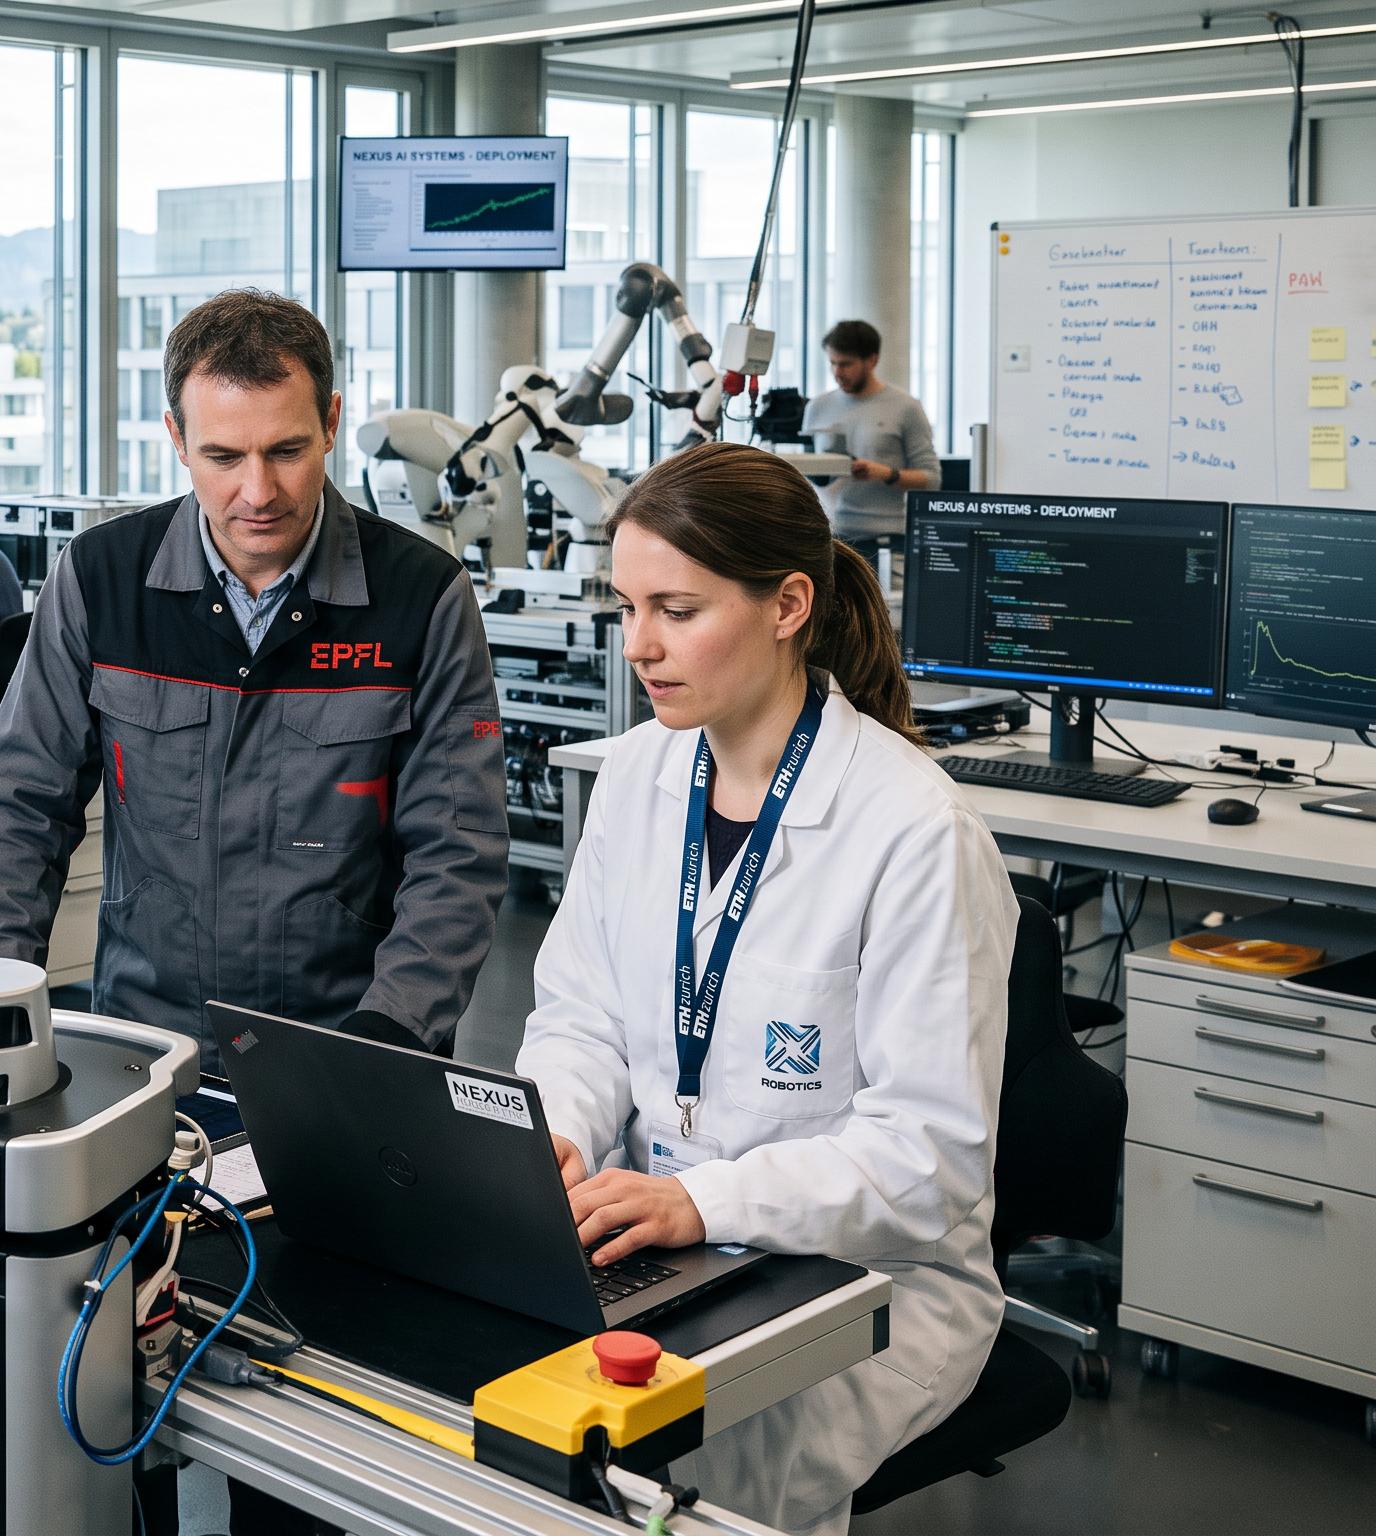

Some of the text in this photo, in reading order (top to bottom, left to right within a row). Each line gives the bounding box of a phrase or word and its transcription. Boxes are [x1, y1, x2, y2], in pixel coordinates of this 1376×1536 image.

[353, 151, 392, 161] NEXUS
[396, 151, 407, 161] AI
[410, 151, 465, 161] SYSTEMS
[476, 151, 556, 161] DEPLOYMENT
[928, 501, 965, 514] NEXUS
[966, 502, 979, 514] AI
[980, 502, 1032, 516] SYSTEMS
[1041, 505, 1117, 519] DEPLOYMENT
[310, 642, 393, 669] EPFL
[761, 1077, 823, 1091] ROBOTICS
[452, 1080, 524, 1112] NEXUS
